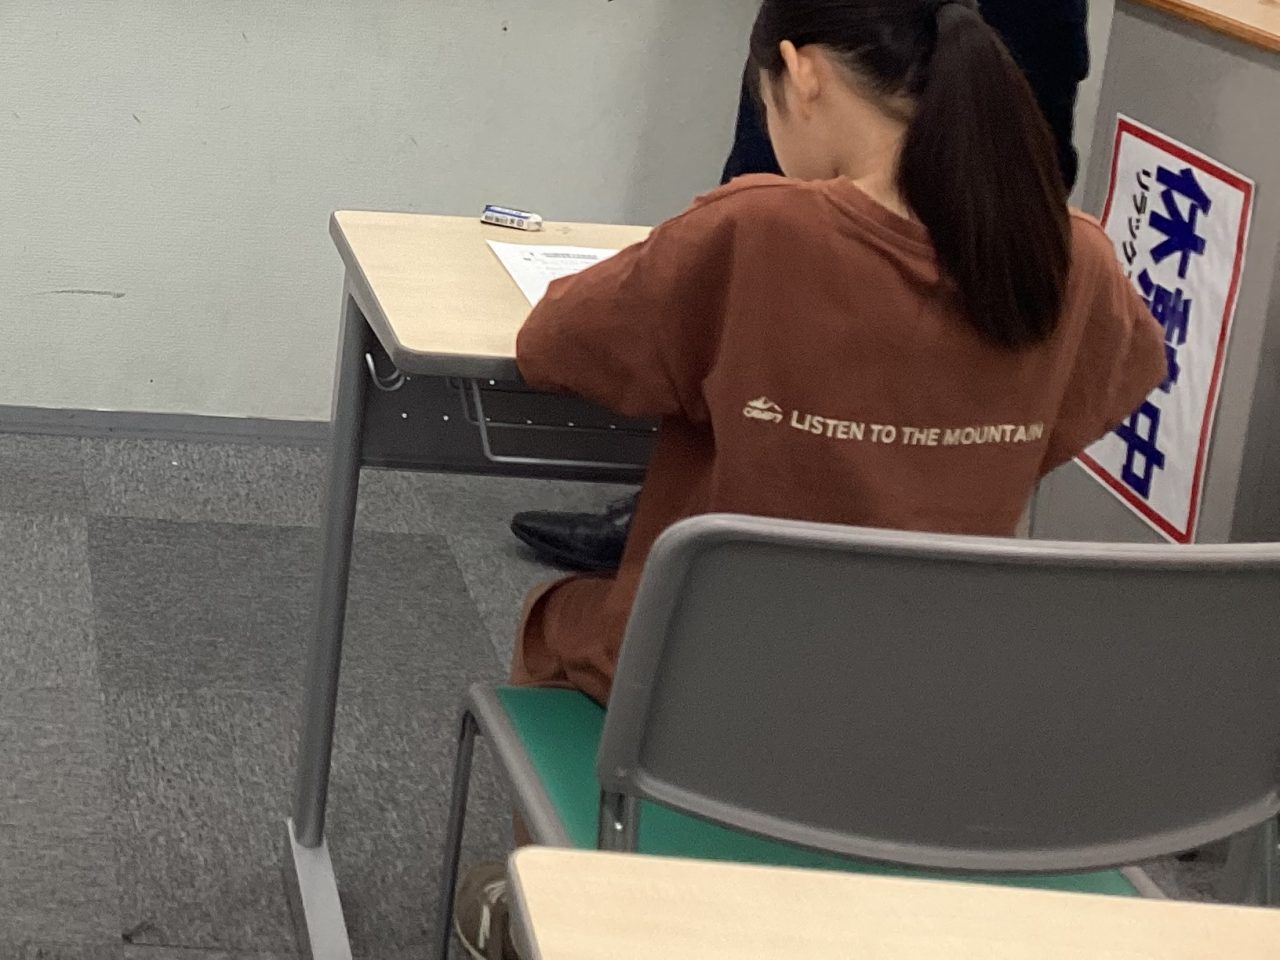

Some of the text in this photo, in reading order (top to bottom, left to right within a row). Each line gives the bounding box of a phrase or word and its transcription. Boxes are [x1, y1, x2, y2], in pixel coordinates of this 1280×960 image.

[1122, 168, 1152, 280] リラック
[790, 409, 866, 441] LISTEN
[870, 423, 897, 444] TO
[901, 426, 942, 446] THE
